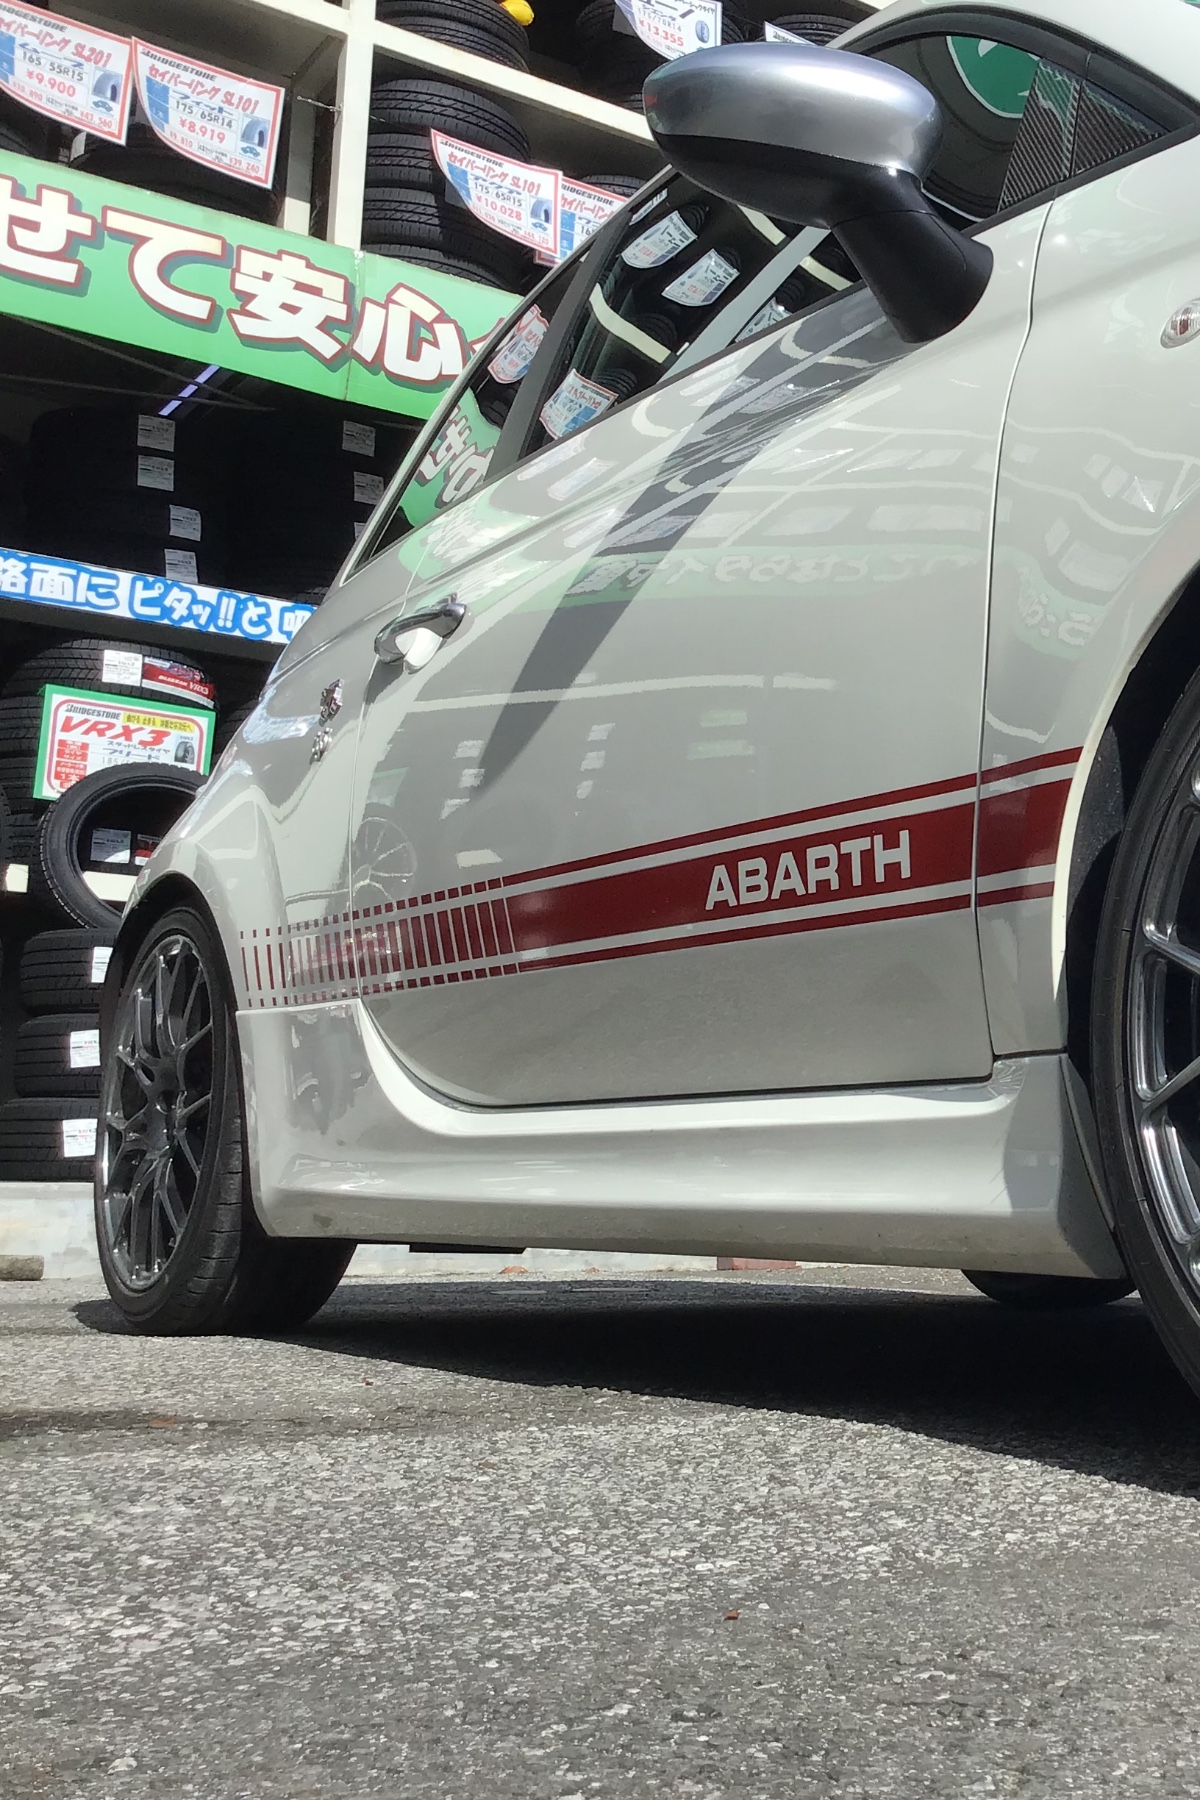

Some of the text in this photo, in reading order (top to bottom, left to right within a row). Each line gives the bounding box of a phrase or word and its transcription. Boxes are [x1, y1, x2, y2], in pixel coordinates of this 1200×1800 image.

[22, 51, 84, 82] 165/55R15
[71, 41, 112, 68] SL201
[140, 47, 217, 82] BRIDGESTONE
[148, 64, 221, 100] セイバーリング
[220, 90, 260, 115] SL101
[175, 100, 233, 130] 175/65R14
[439, 138, 504, 169] BRIDGESTONE
[448, 151, 542, 196] セイバーリング SL101
[474, 181, 523, 207] 175/65R15
[0, 174, 505, 384] せて安心
[64, 704, 121, 720] BRIDGESTONE
[60, 715, 171, 746] VRX3
[107, 740, 170, 754] スタッドレスタイヤ
[705, 829, 911, 911] ABARTH
